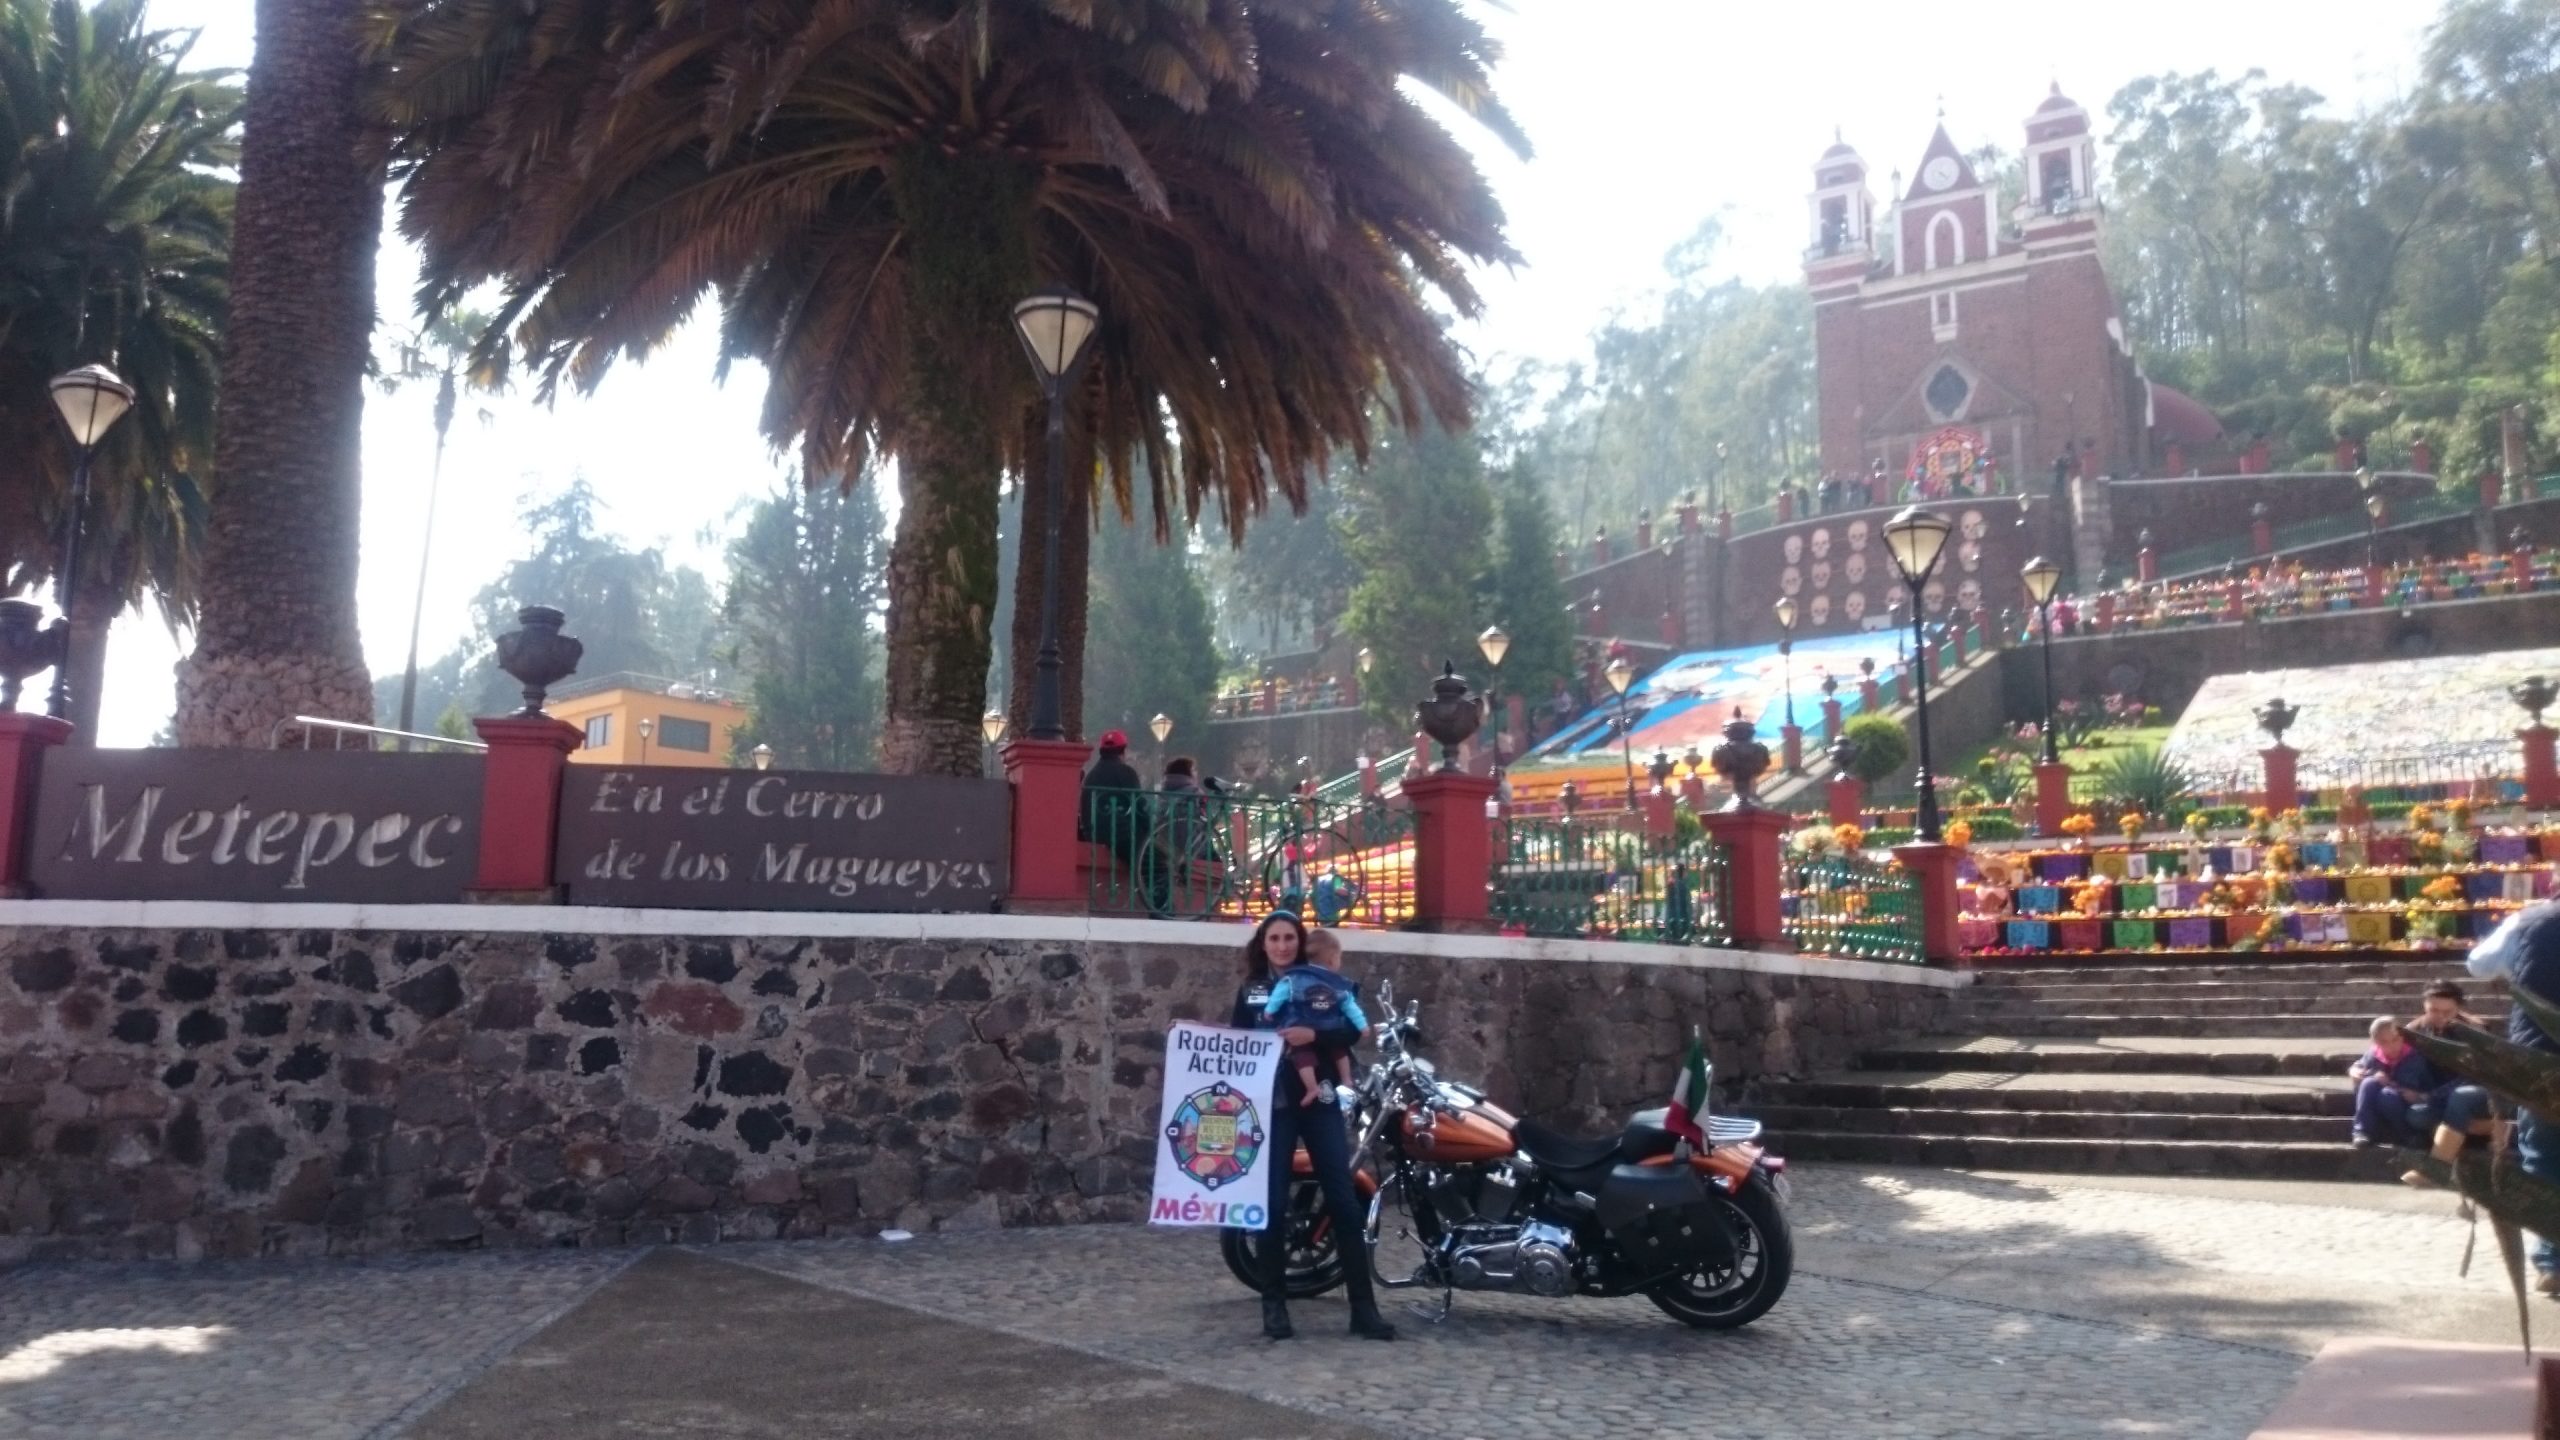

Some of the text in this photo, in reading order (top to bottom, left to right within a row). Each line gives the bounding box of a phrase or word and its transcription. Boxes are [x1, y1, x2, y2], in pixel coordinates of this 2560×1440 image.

[590, 772, 885, 820] En el Cerro
[58, 782, 463, 889] Metepec
[585, 838, 992, 897] de los Magueyes
[1178, 1030, 1273, 1057] Rodador
[1187, 1053, 1257, 1077] Activo
[1216, 1086, 1228, 1094] N
